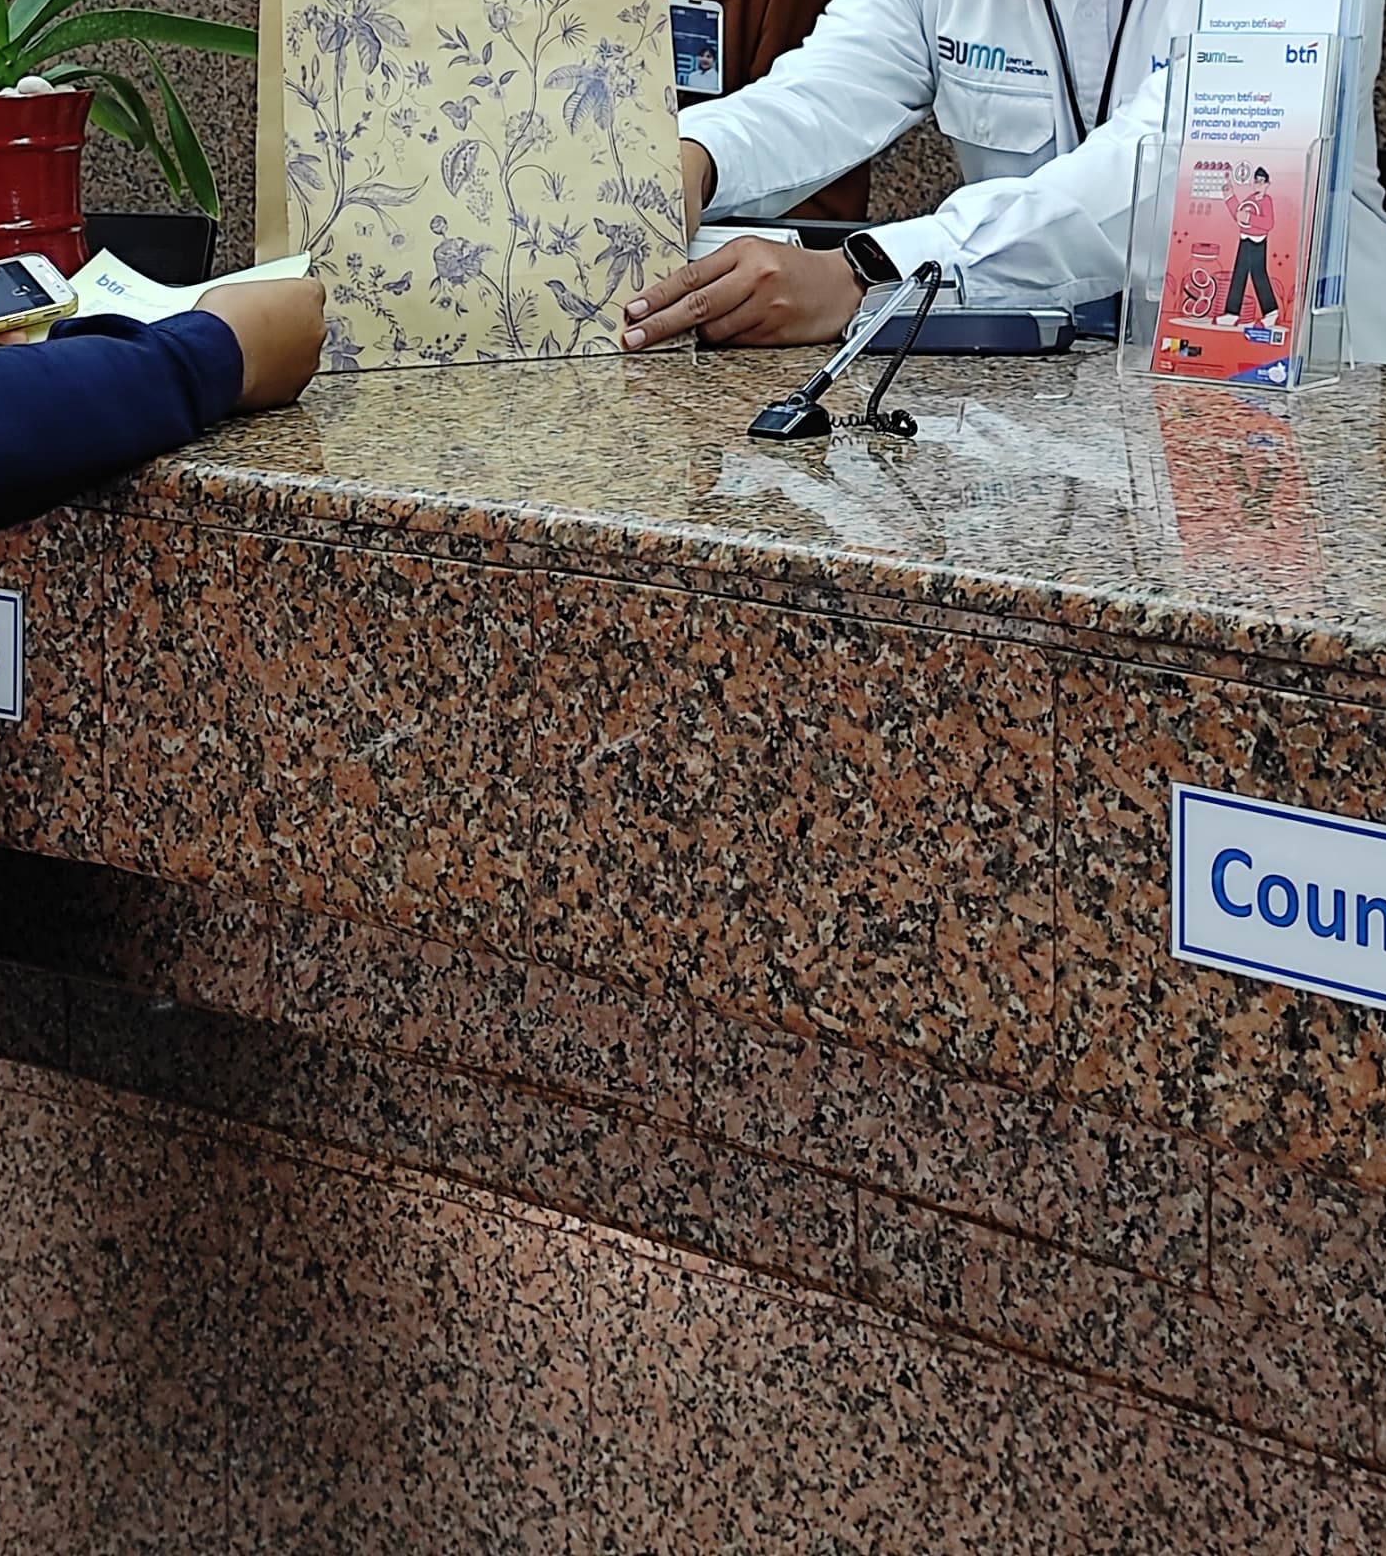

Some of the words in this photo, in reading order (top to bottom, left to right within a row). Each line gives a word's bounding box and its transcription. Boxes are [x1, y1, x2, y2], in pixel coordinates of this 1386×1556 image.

[1285, 42, 1319, 64] btn
[1193, 105, 1220, 115] solusi
[1221, 106, 1285, 118] menciptakan
[1191, 118, 1231, 128] rencana
[1232, 118, 1281, 131] keuangan
[1190, 130, 1200, 140] di
[1200, 131, 1228, 140] masa
[1229, 131, 1260, 143] depan
